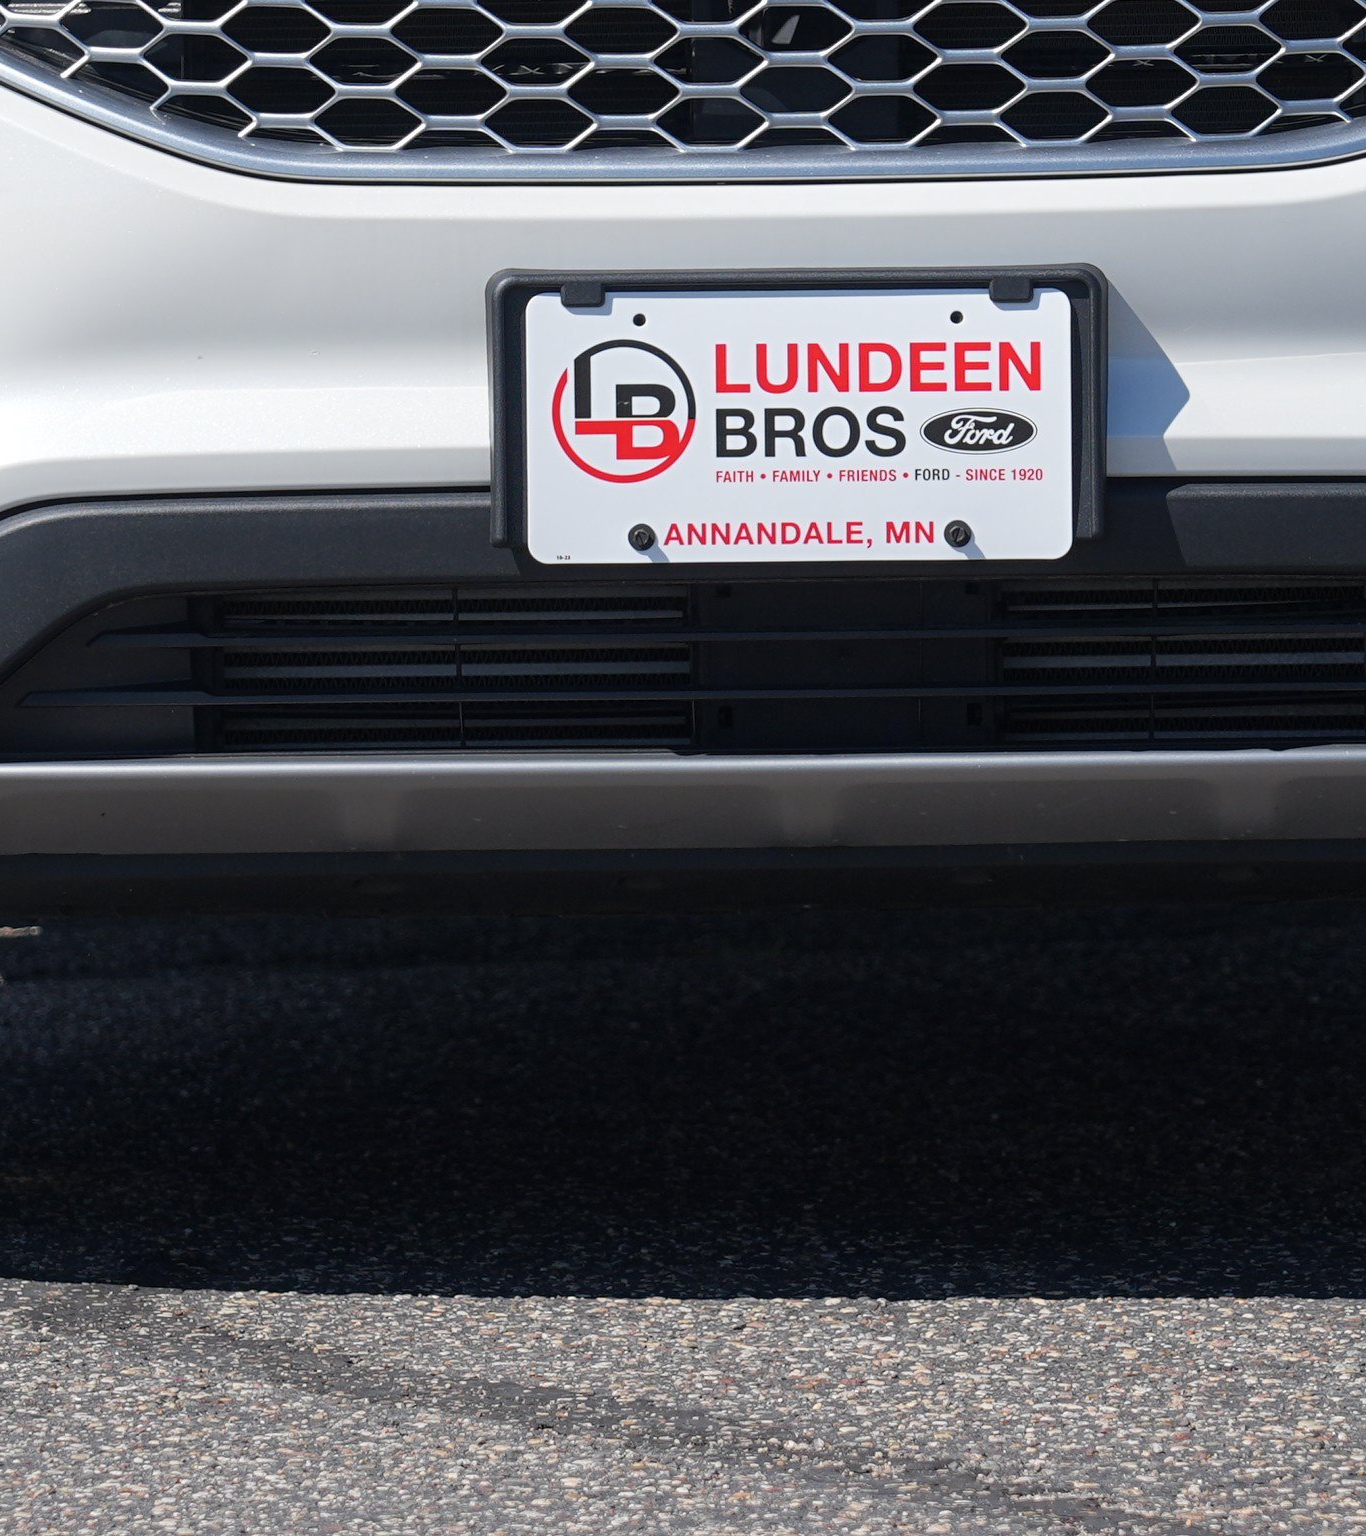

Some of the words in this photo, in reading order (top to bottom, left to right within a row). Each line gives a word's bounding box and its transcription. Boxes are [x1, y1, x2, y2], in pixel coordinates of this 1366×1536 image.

[715, 341, 1042, 395] LUNDEEN
[715, 405, 907, 459] BROS
[943, 414, 1015, 445] Ford
[715, 470, 754, 483] FAITH
[772, 469, 821, 483] FAMILY
[838, 468, 897, 482] FRIENDS
[914, 468, 951, 482] FORD
[965, 468, 1006, 482] SINCE
[1010, 468, 1044, 481] 1920
[663, 521, 873, 549] ANNANDALE,
[885, 520, 935, 544] MN
